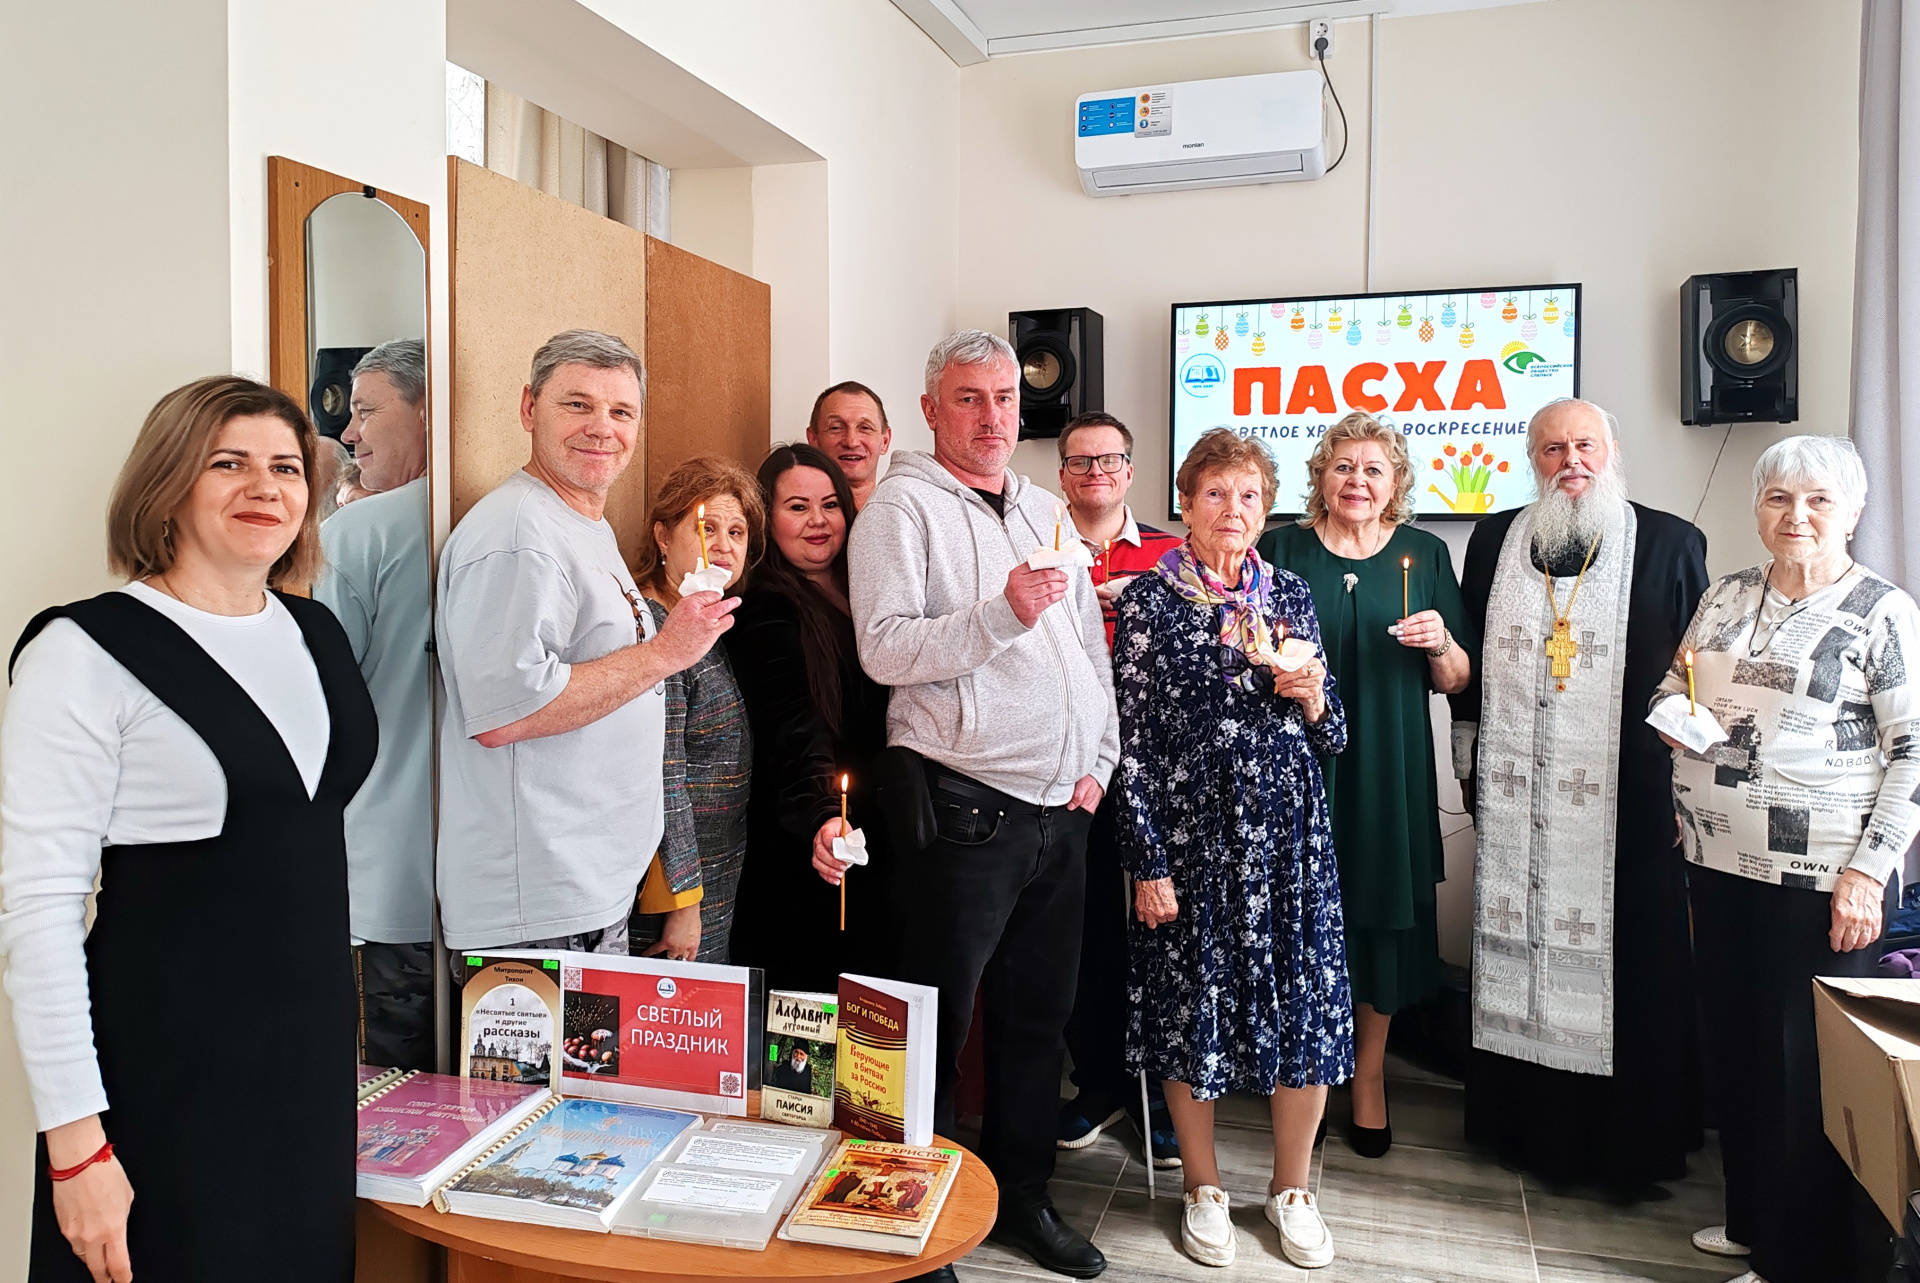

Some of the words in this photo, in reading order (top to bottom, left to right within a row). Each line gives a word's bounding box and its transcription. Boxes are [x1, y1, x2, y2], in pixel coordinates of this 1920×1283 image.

[1233, 359, 1507, 416] ПАСХА
[1233, 426, 1299, 439] ВЕТЛОЕ
[1403, 421, 1527, 436] ВОСКРЕСЕНИЕ
[1790, 860, 1830, 873] OWN
[494, 966, 533, 975] Митрополит
[510, 997, 515, 1006] 1
[476, 1008, 515, 1017] «Несвятые
[637, 1005, 722, 1029] СВЕТЛЫЙ
[846, 1002, 860, 1015] БОГ
[861, 1006, 868, 1018] И
[868, 1009, 899, 1032] ПОБЕДА
[483, 1026, 540, 1039] рассказы
[631, 1029, 728, 1055] ПРАЗДНИК
[850, 1044, 890, 1072] Верующие
[854, 1061, 859, 1069] в
[860, 1063, 884, 1081] битвах
[851, 1072, 859, 1081] за
[860, 1074, 887, 1094] Россию
[776, 1099, 813, 1115] ПАИСИЯ
[848, 1142, 890, 1153] КРЕСТ
[892, 1146, 951, 1160] ХРИСТОВ
